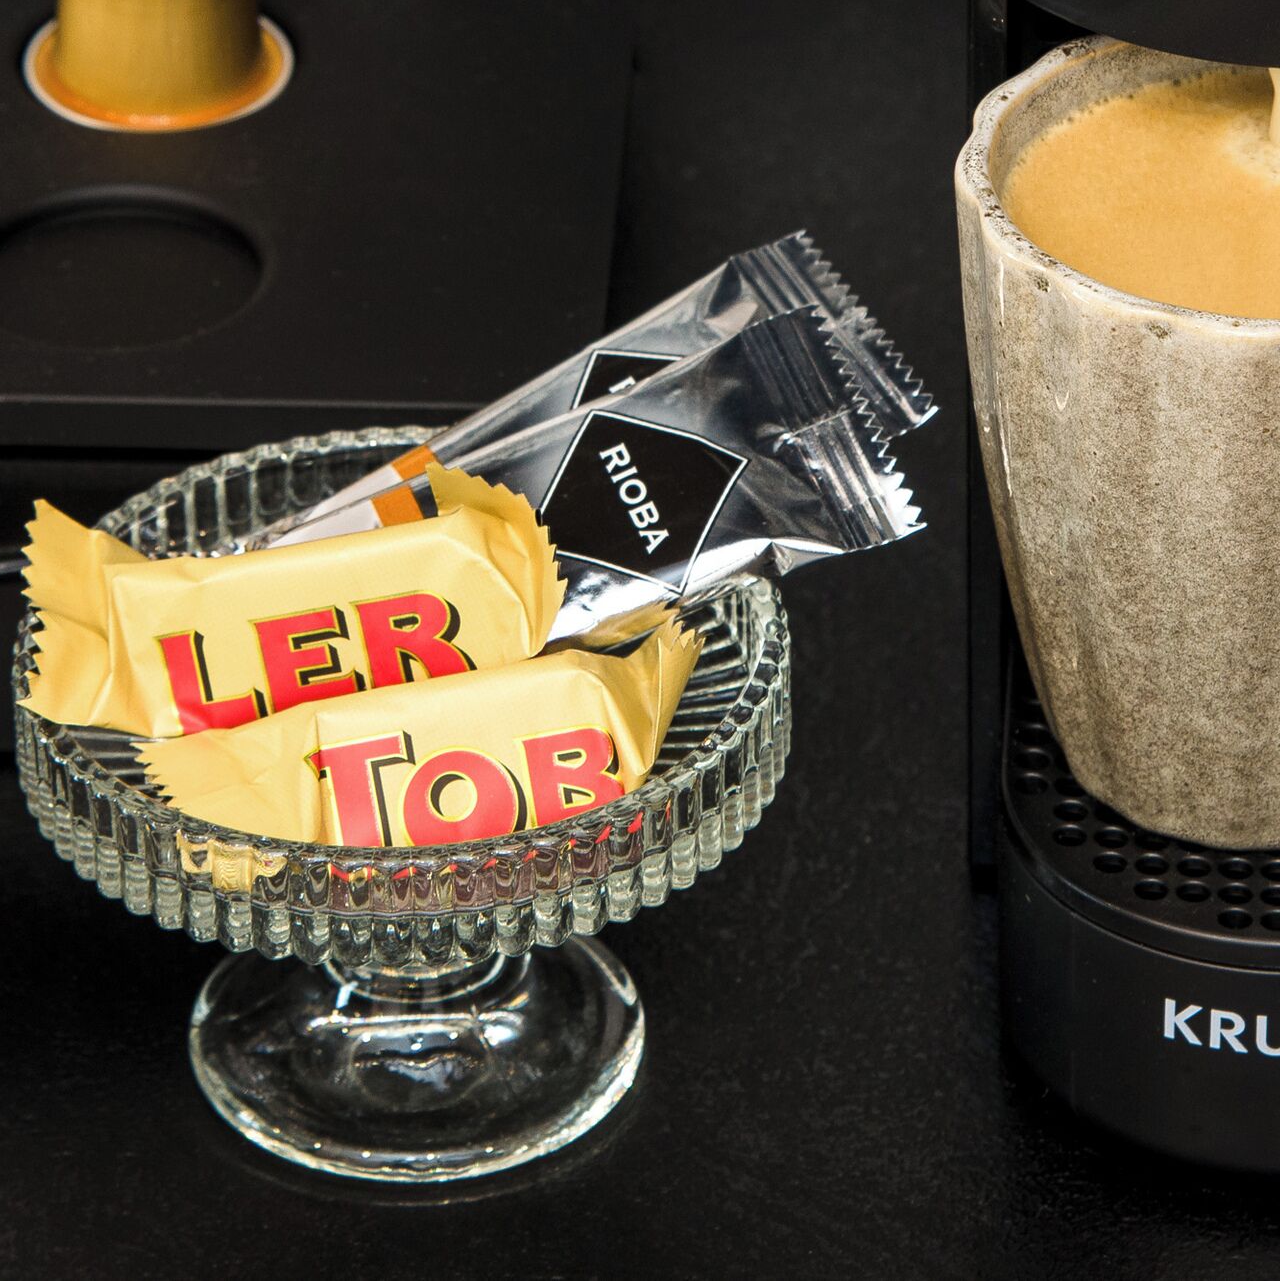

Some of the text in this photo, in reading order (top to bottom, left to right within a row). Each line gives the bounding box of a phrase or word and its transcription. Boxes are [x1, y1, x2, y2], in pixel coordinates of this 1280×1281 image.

[600, 443, 669, 554] RIOBA
[155, 591, 476, 735] LER
[304, 727, 626, 846] TOB
